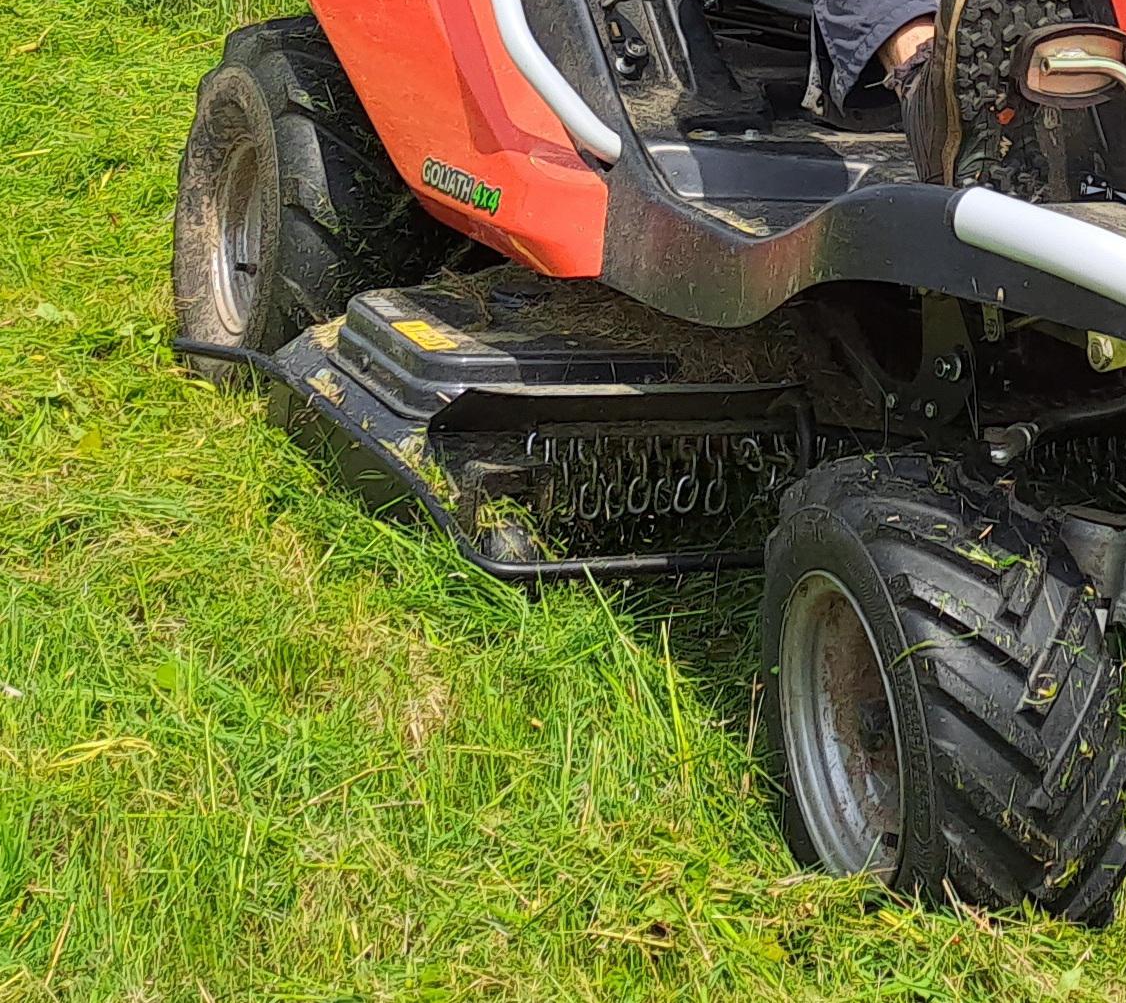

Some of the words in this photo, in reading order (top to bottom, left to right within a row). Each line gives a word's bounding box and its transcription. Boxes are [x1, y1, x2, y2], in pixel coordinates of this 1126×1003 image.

[422, 158, 474, 203] GOLIATH
[1080, 182, 1087, 195] R
[1106, 187, 1113, 201] N
